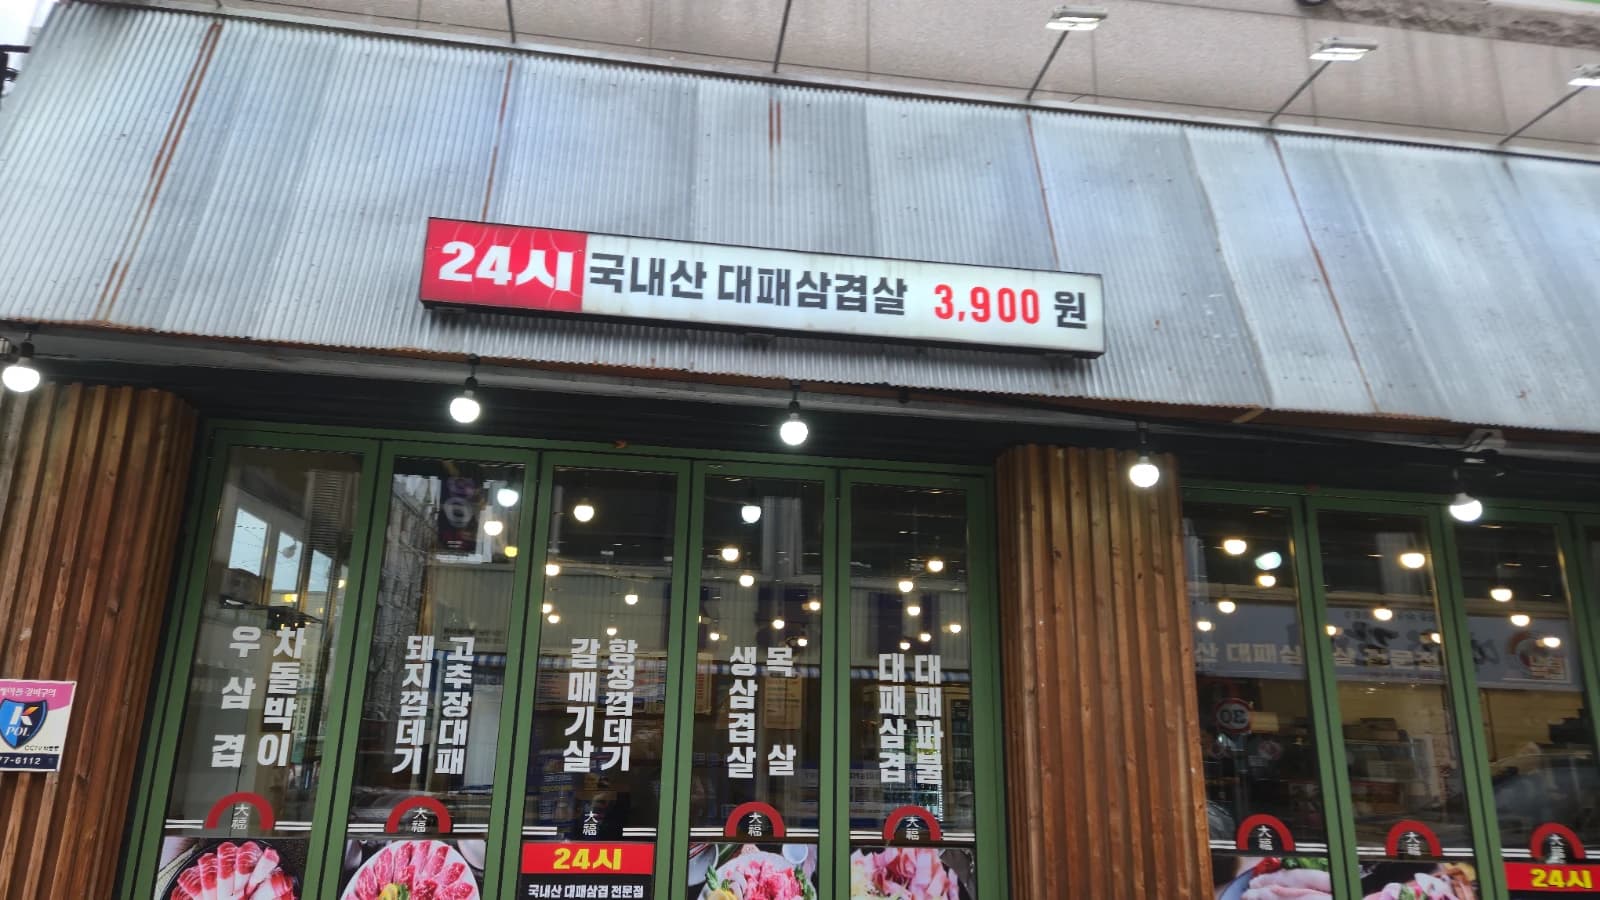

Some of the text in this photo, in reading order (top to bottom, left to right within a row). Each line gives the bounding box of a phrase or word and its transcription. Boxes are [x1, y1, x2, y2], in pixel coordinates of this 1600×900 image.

[439, 240, 1089, 331] 24시 국내산 대패삼겹살 3,900 원
[6, 726, 30, 737] POL
[256, 626, 308, 768] 차돌박이
[391, 635, 436, 775] 돼지껍데기
[433, 636, 476, 775] 고추장대패
[563, 638, 602, 774] 갈매기살
[599, 638, 639, 772] 항정껍데기
[726, 645, 759, 779] 생삼겹살
[877, 652, 907, 785] 대패삼겹
[527, 884, 644, 899] 국내산 대패삼겹 전문점
[552, 847, 622, 871] 24시
[747, 812, 764, 838] 大福
[1530, 868, 1593, 889] 24시
